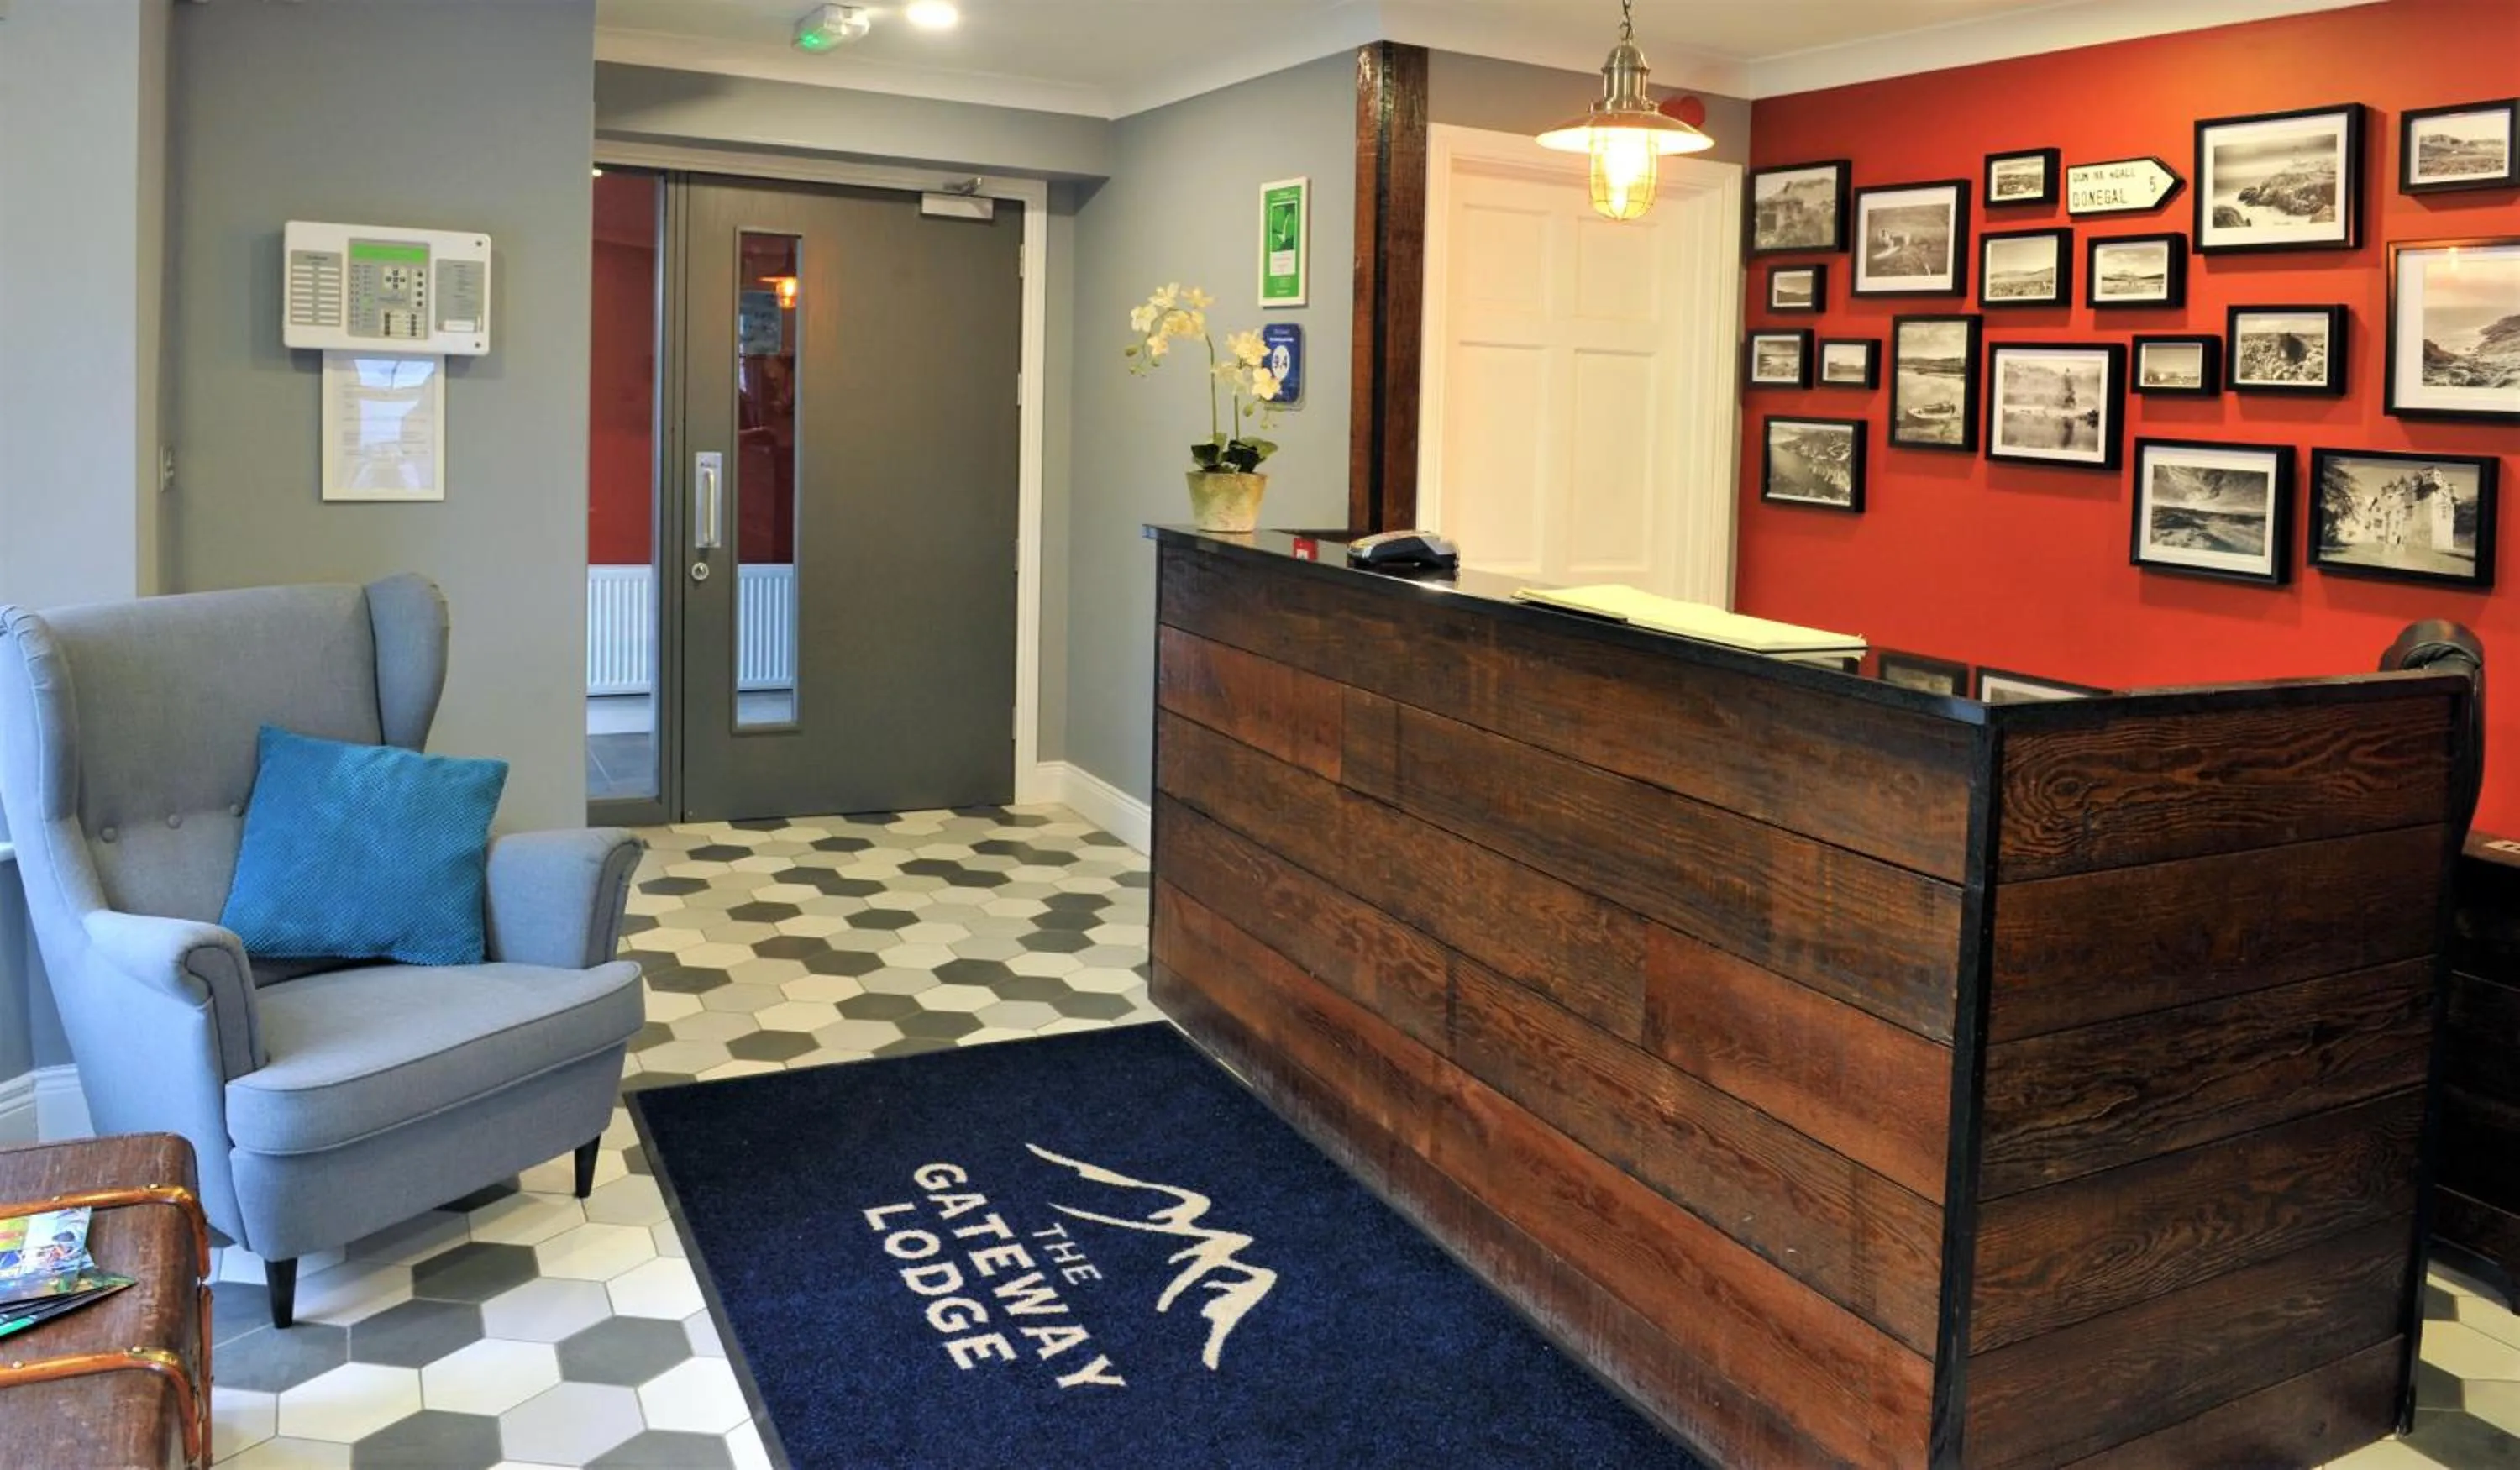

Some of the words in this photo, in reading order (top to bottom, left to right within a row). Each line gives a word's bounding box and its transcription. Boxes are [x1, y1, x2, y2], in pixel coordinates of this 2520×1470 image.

[2072, 188, 2128, 207] DONEGAL
[2149, 175, 2157, 192] 5
[861, 1202, 1017, 1370] LODGE
[913, 1163, 1126, 1389] GATEWAY
[1032, 1222, 1103, 1286] THE
